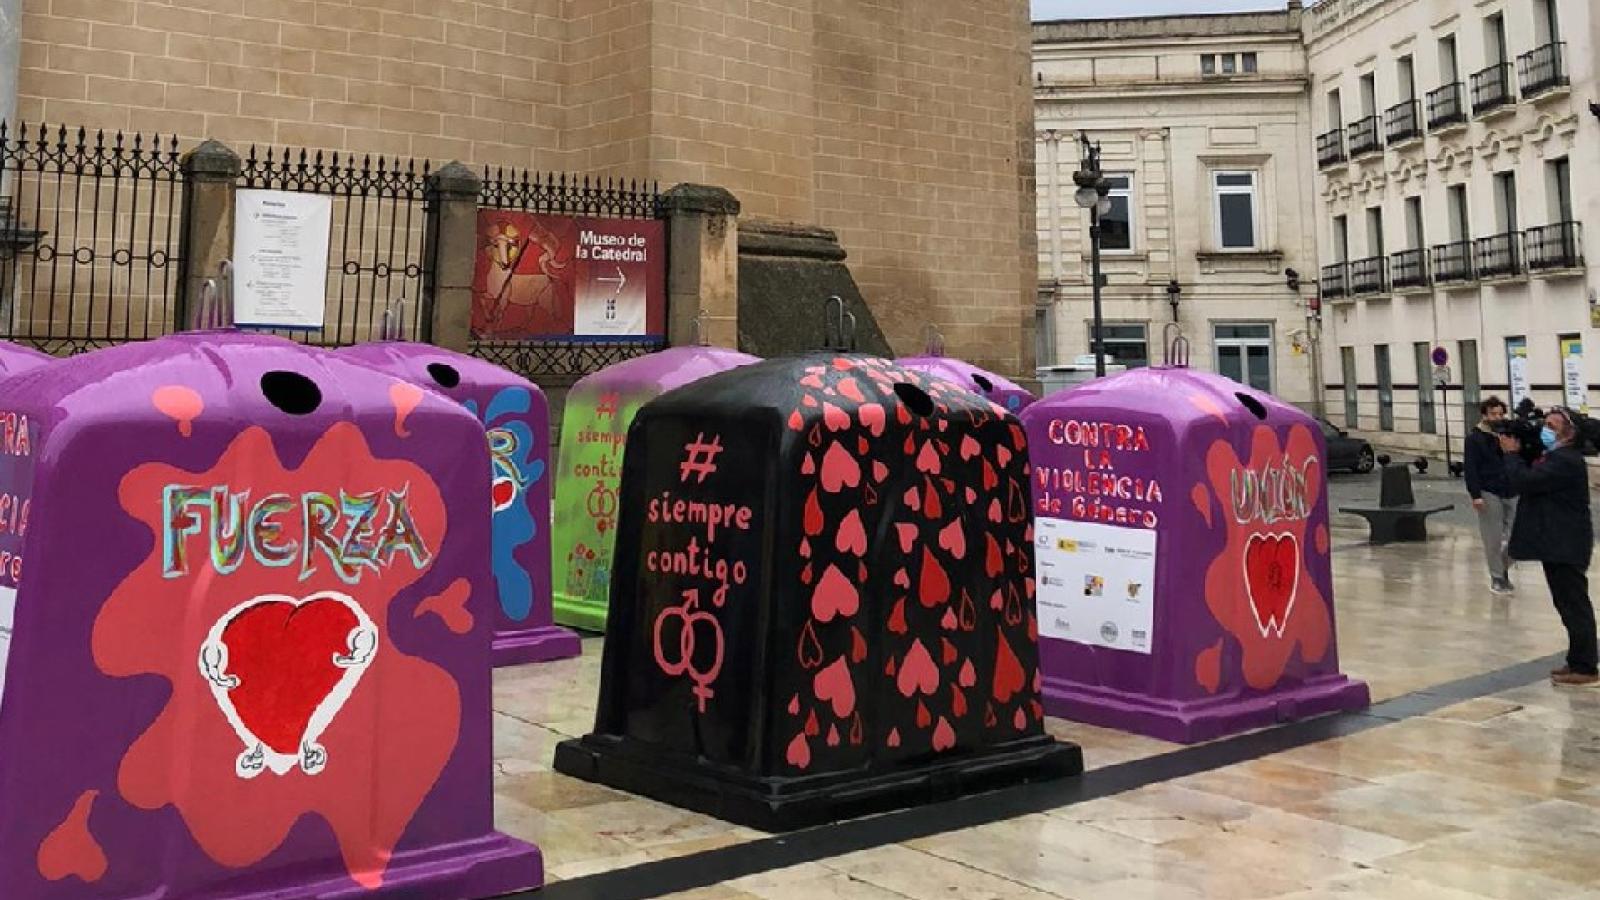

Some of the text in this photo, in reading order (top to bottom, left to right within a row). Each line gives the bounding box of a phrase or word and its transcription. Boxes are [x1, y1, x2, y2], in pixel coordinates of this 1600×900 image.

[575, 245, 647, 262] la Catedral
[580, 230, 646, 247] Museo de
[1048, 419, 1150, 451] CONTRA
[1083, 449, 1114, 471] LA
[1034, 465, 1163, 504] VIOLENCIA
[648, 491, 752, 542] siempre
[1036, 491, 1062, 514] de
[161, 482, 432, 585] FUERZA
[647, 536, 747, 607] contigo
